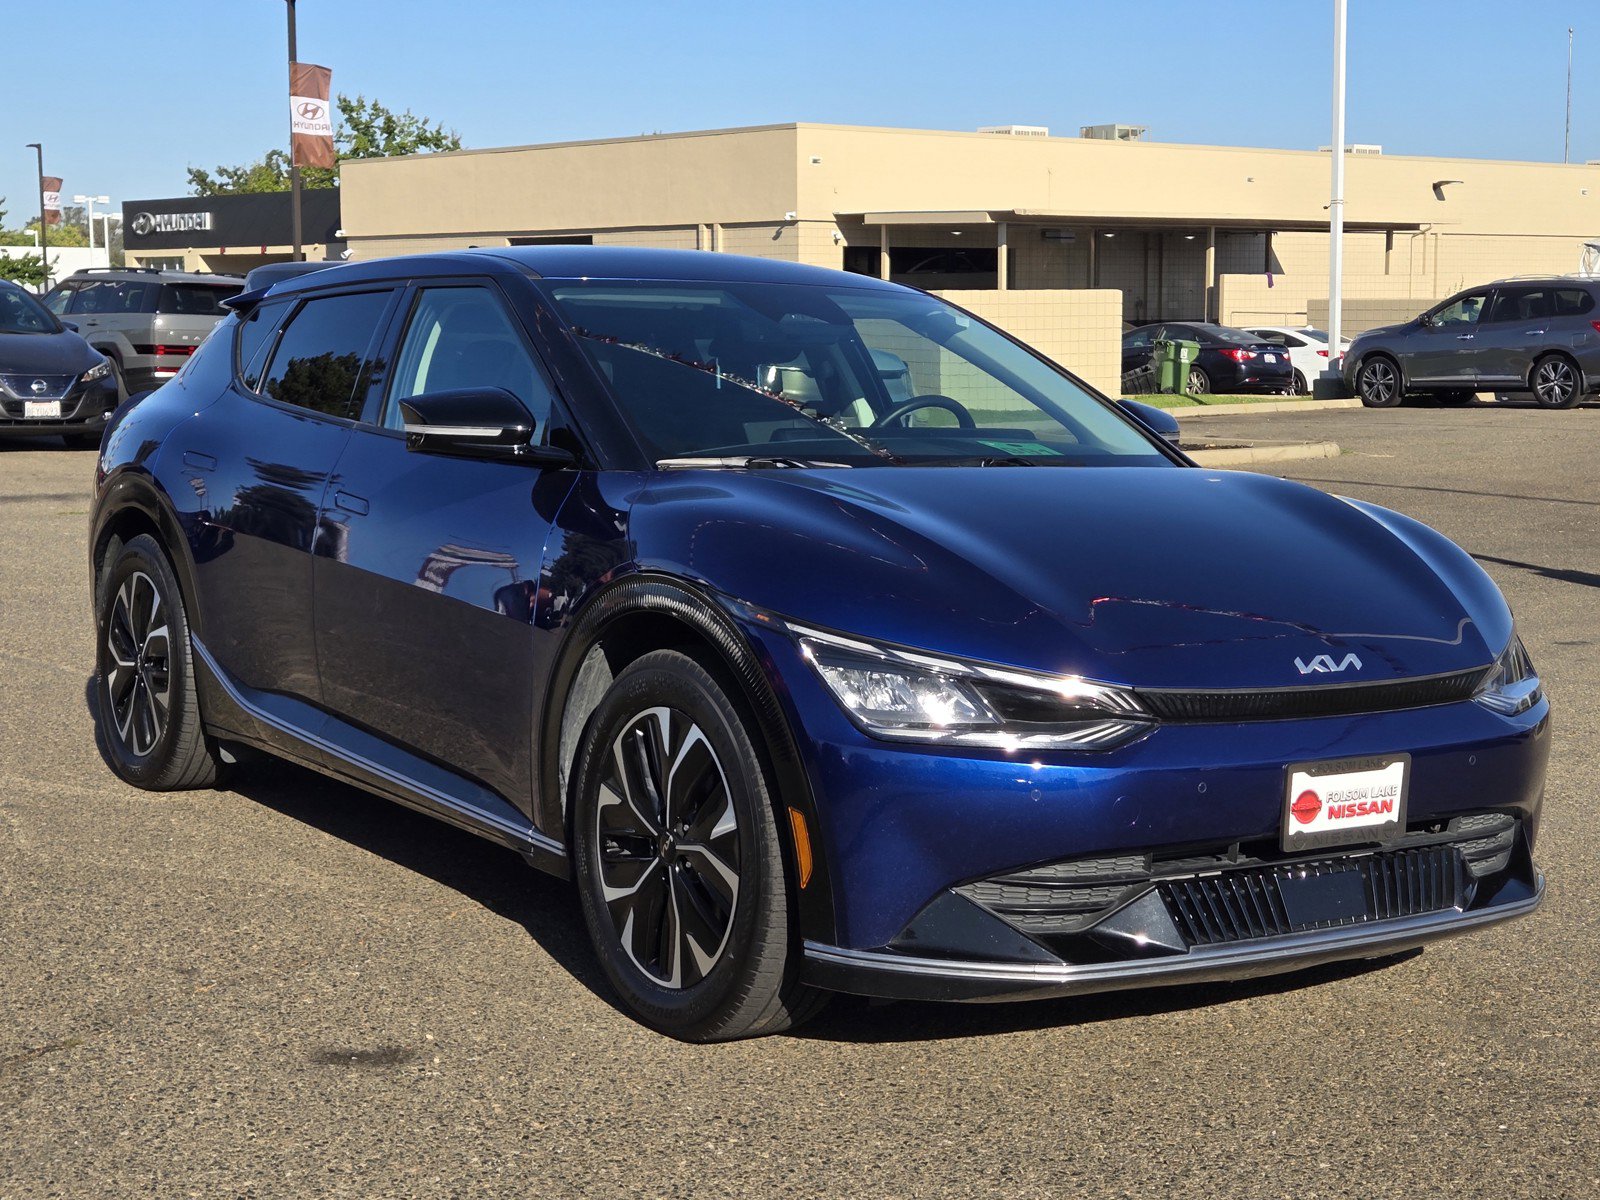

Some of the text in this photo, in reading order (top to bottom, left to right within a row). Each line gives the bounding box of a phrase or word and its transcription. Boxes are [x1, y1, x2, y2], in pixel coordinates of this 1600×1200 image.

[293, 121, 330, 131] HYUNDAI
[1294, 653, 1363, 675] KIA
[1317, 758, 1384, 773] FOLSOM LAKE
[1326, 785, 1398, 803] FOLSOM LAKE
[1328, 799, 1393, 820] NISSAN
[1313, 828, 1379, 844] NISSAN
